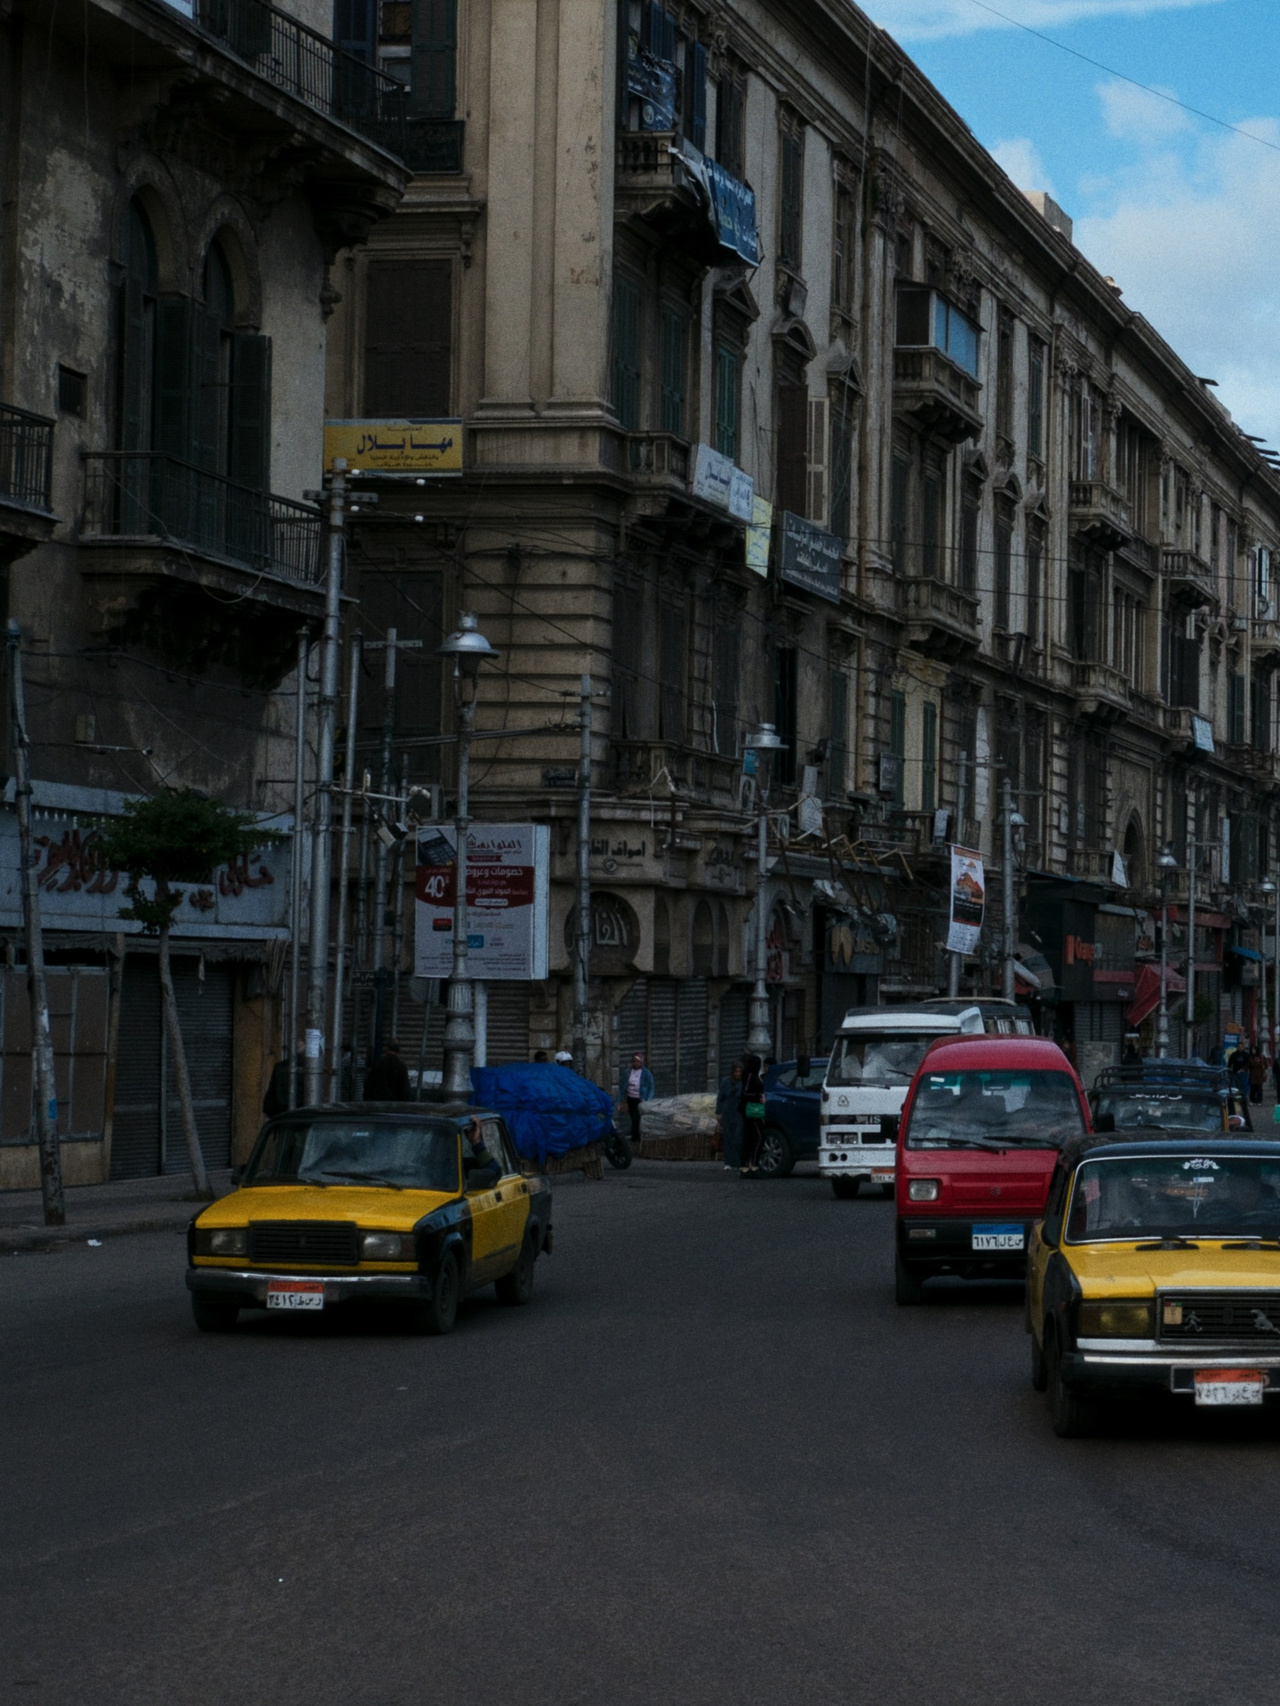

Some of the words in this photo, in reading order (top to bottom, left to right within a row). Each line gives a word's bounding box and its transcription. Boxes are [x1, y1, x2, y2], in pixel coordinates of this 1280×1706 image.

[356, 433, 406, 455] بلال
[410, 433, 453, 454] مها
[490, 867, 523, 878] خصومات
[424, 875, 446, 898] 40
